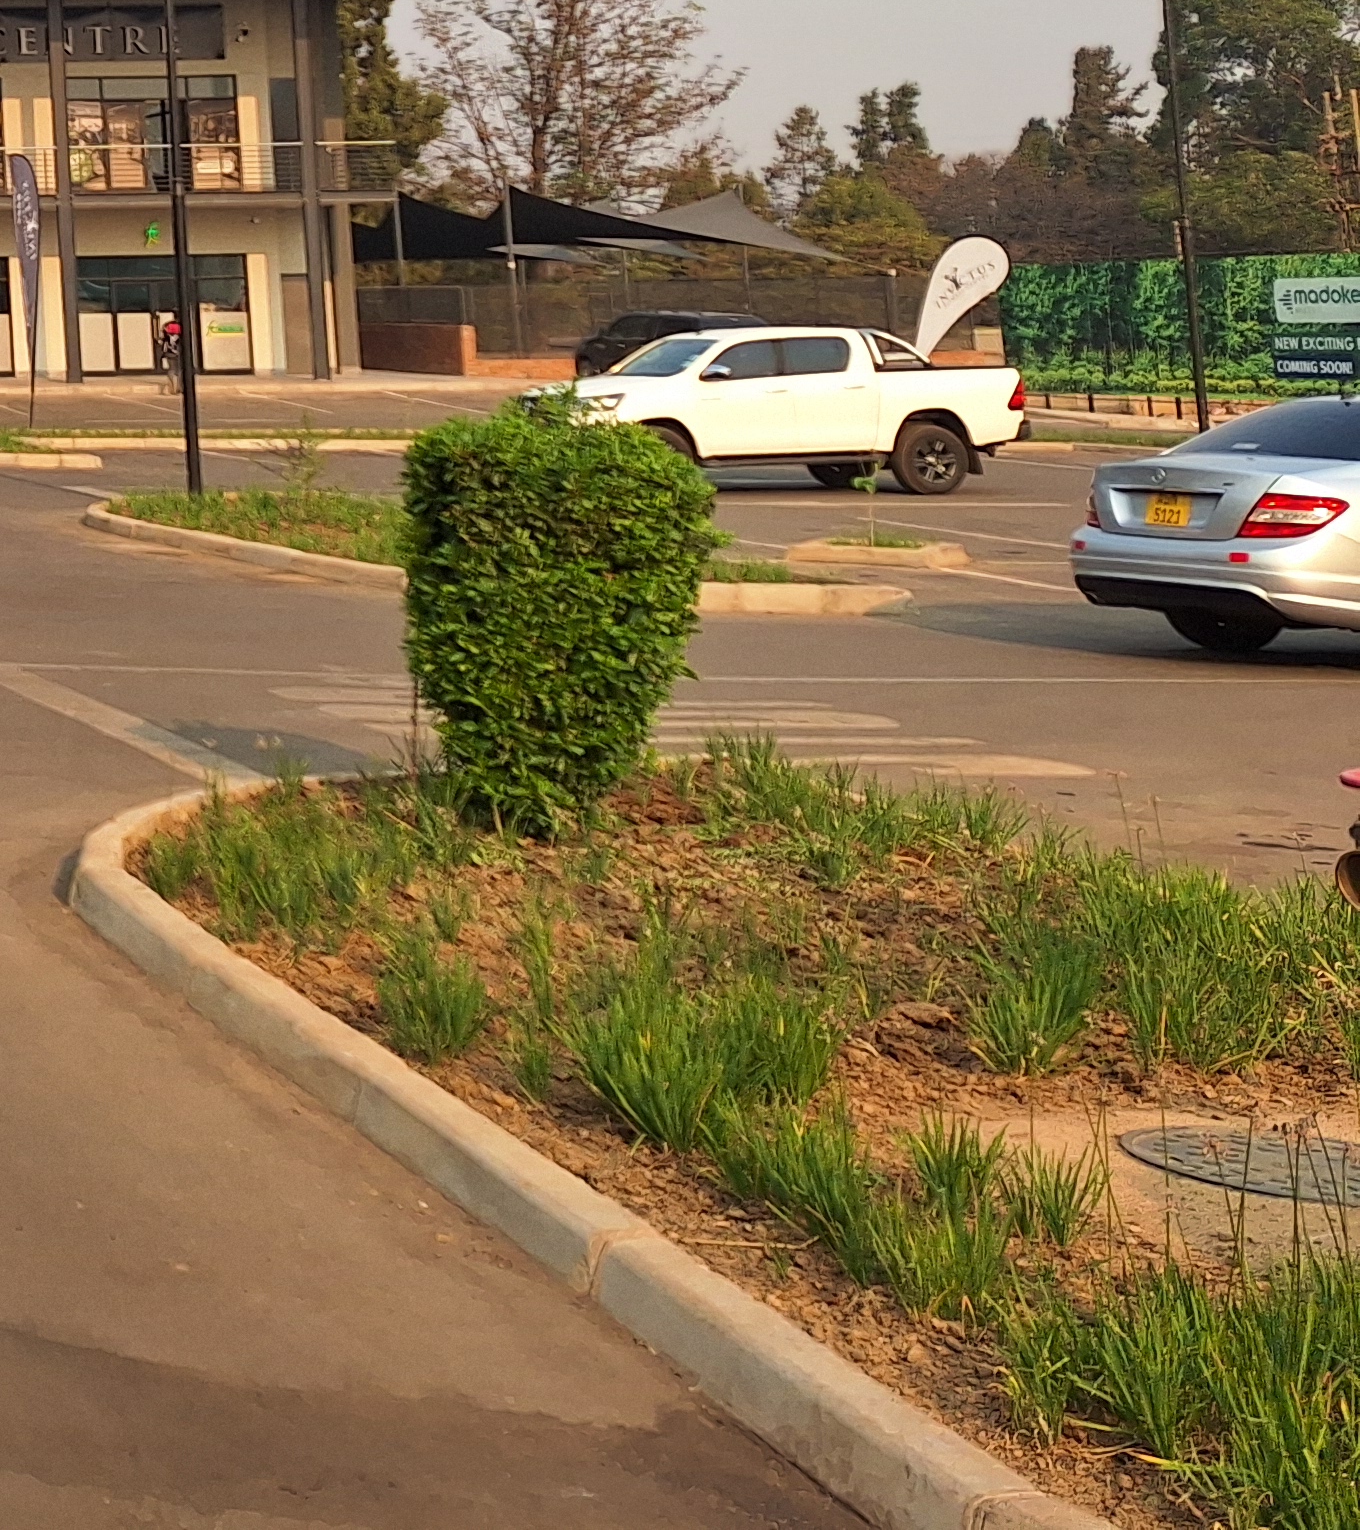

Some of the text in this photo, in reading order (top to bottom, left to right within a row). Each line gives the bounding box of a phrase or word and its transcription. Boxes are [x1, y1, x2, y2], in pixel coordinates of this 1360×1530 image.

[1275, 337, 1299, 350] NEW
[1301, 337, 1355, 351] EXCITING
[1276, 359, 1354, 375] COMING SOON!
[1153, 507, 1181, 525] 5121
